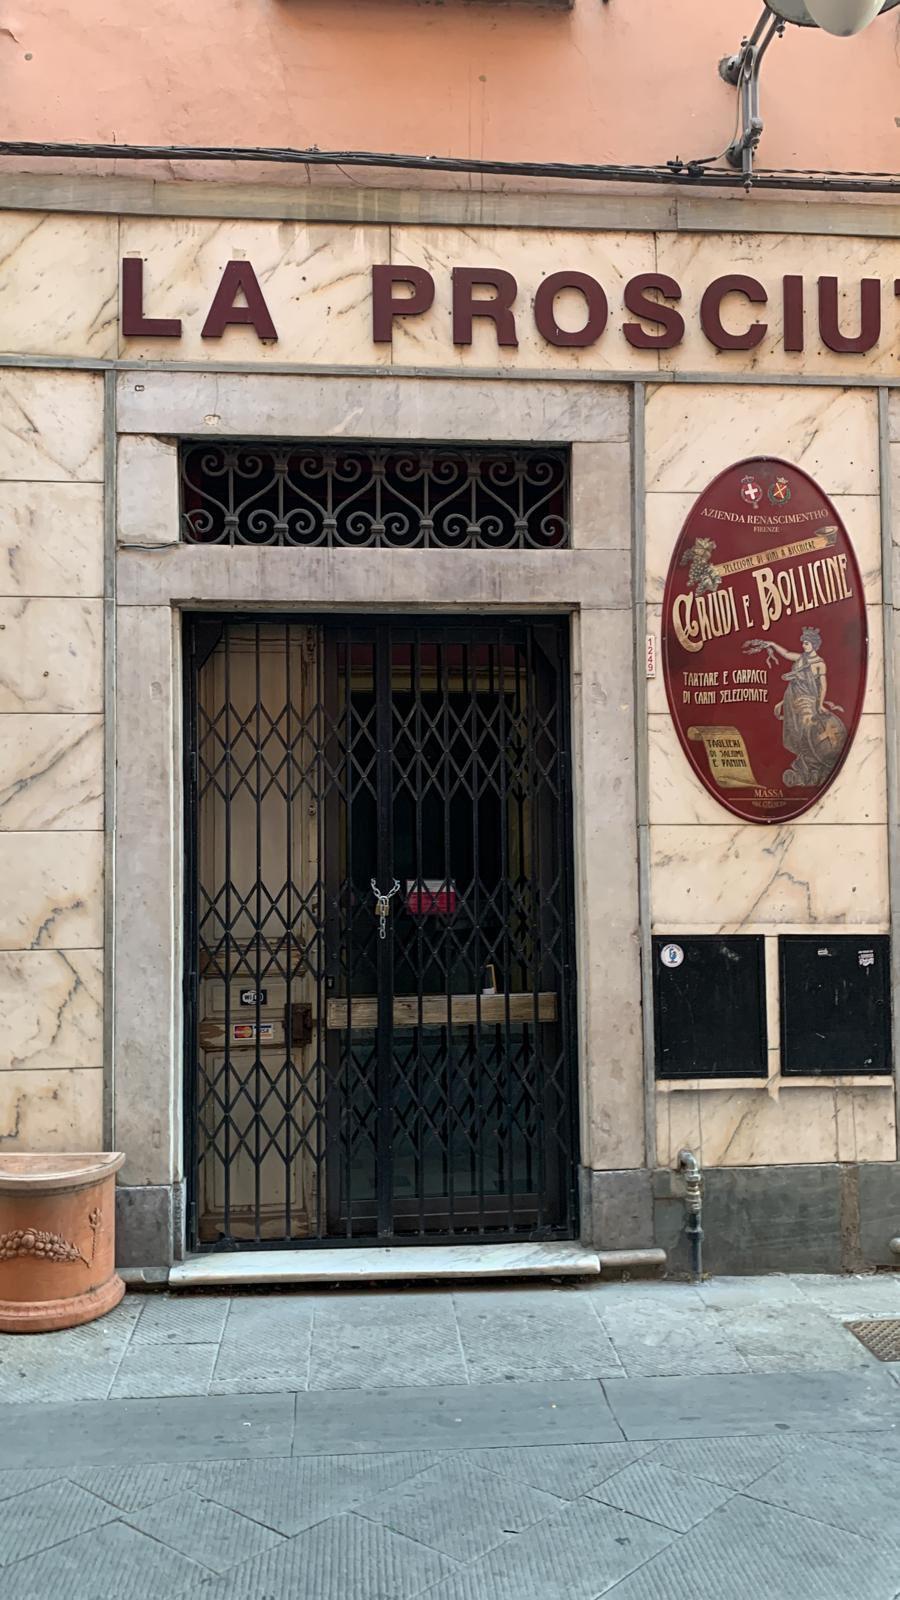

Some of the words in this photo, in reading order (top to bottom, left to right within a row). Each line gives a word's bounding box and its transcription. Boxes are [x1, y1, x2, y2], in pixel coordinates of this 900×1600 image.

[122, 257, 279, 342] LA
[371, 263, 900, 354] PROSCIU
[700, 507, 746, 524] AZIENDA
[747, 508, 829, 525] RENASCIMENTHO
[756, 555, 764, 564] DI
[766, 551, 779, 561] VINI
[672, 586, 740, 653] CRUDI
[752, 553, 853, 631] BOLLICINE
[683, 672, 719, 686] TARTARE
[723, 670, 729, 685] E
[732, 669, 767, 685] CARPACCI
[682, 690, 691, 704] DI
[694, 690, 716, 705] CARNI
[720, 688, 769, 704] SELEZIONATE
[706, 739, 741, 748] TAGLIERI
[721, 759, 747, 768] PANINI
[753, 789, 784, 798] MASSA
